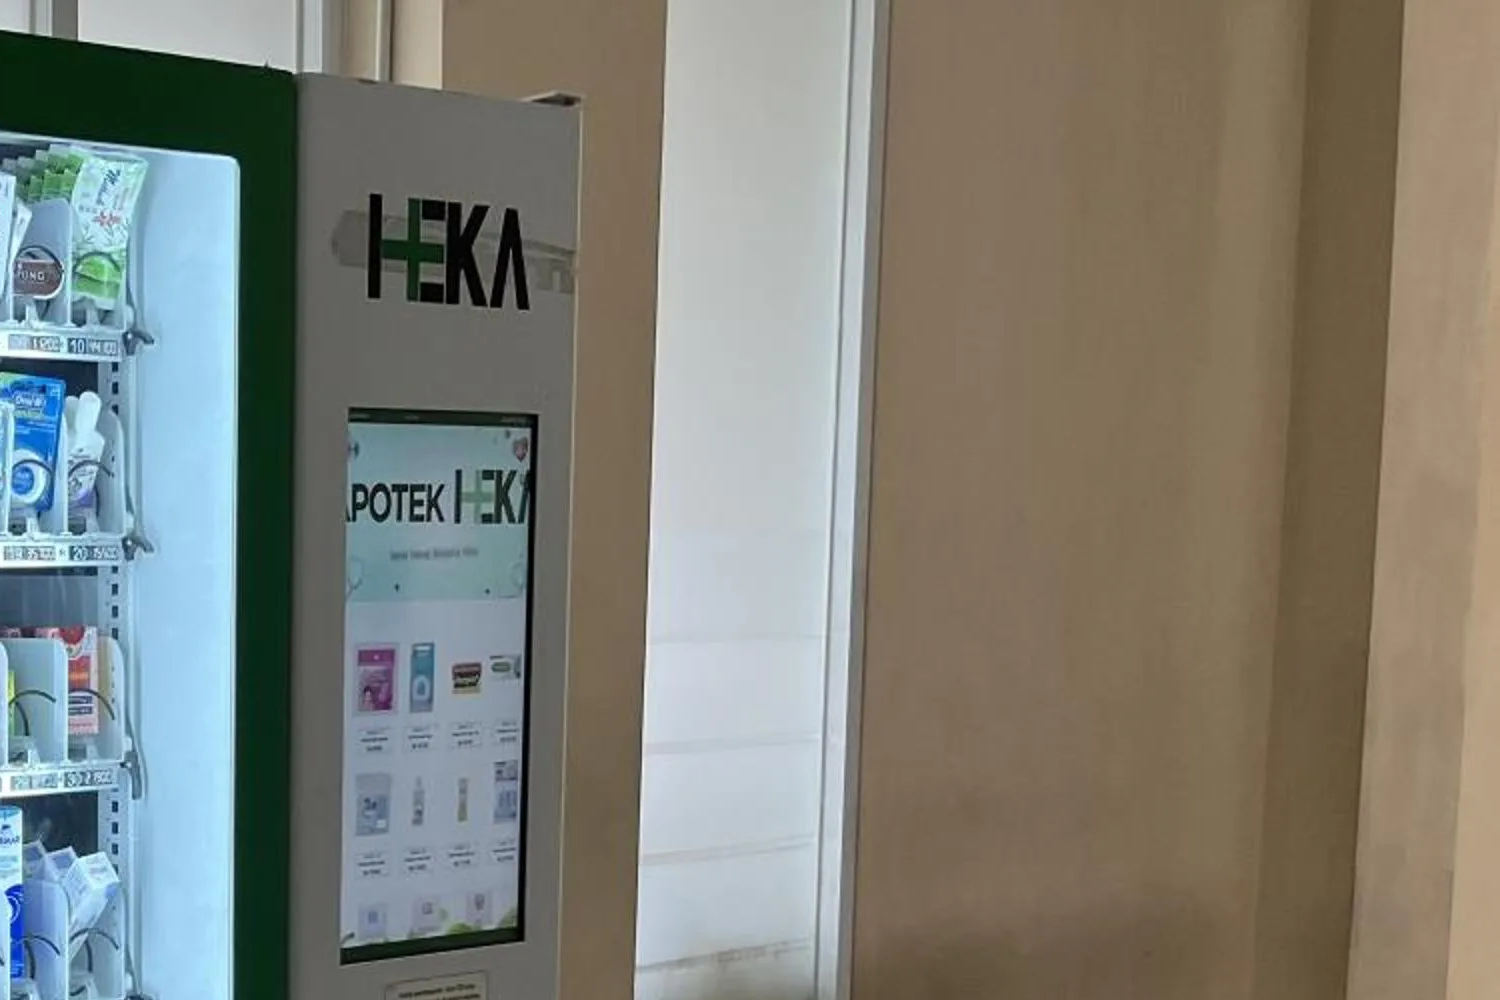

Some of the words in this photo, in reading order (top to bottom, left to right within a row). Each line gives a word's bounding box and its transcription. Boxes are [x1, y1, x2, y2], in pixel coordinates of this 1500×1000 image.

[368, 193, 529, 310] HEKA
[69, 338, 84, 353] 10
[345, 483, 445, 523] POTEK
